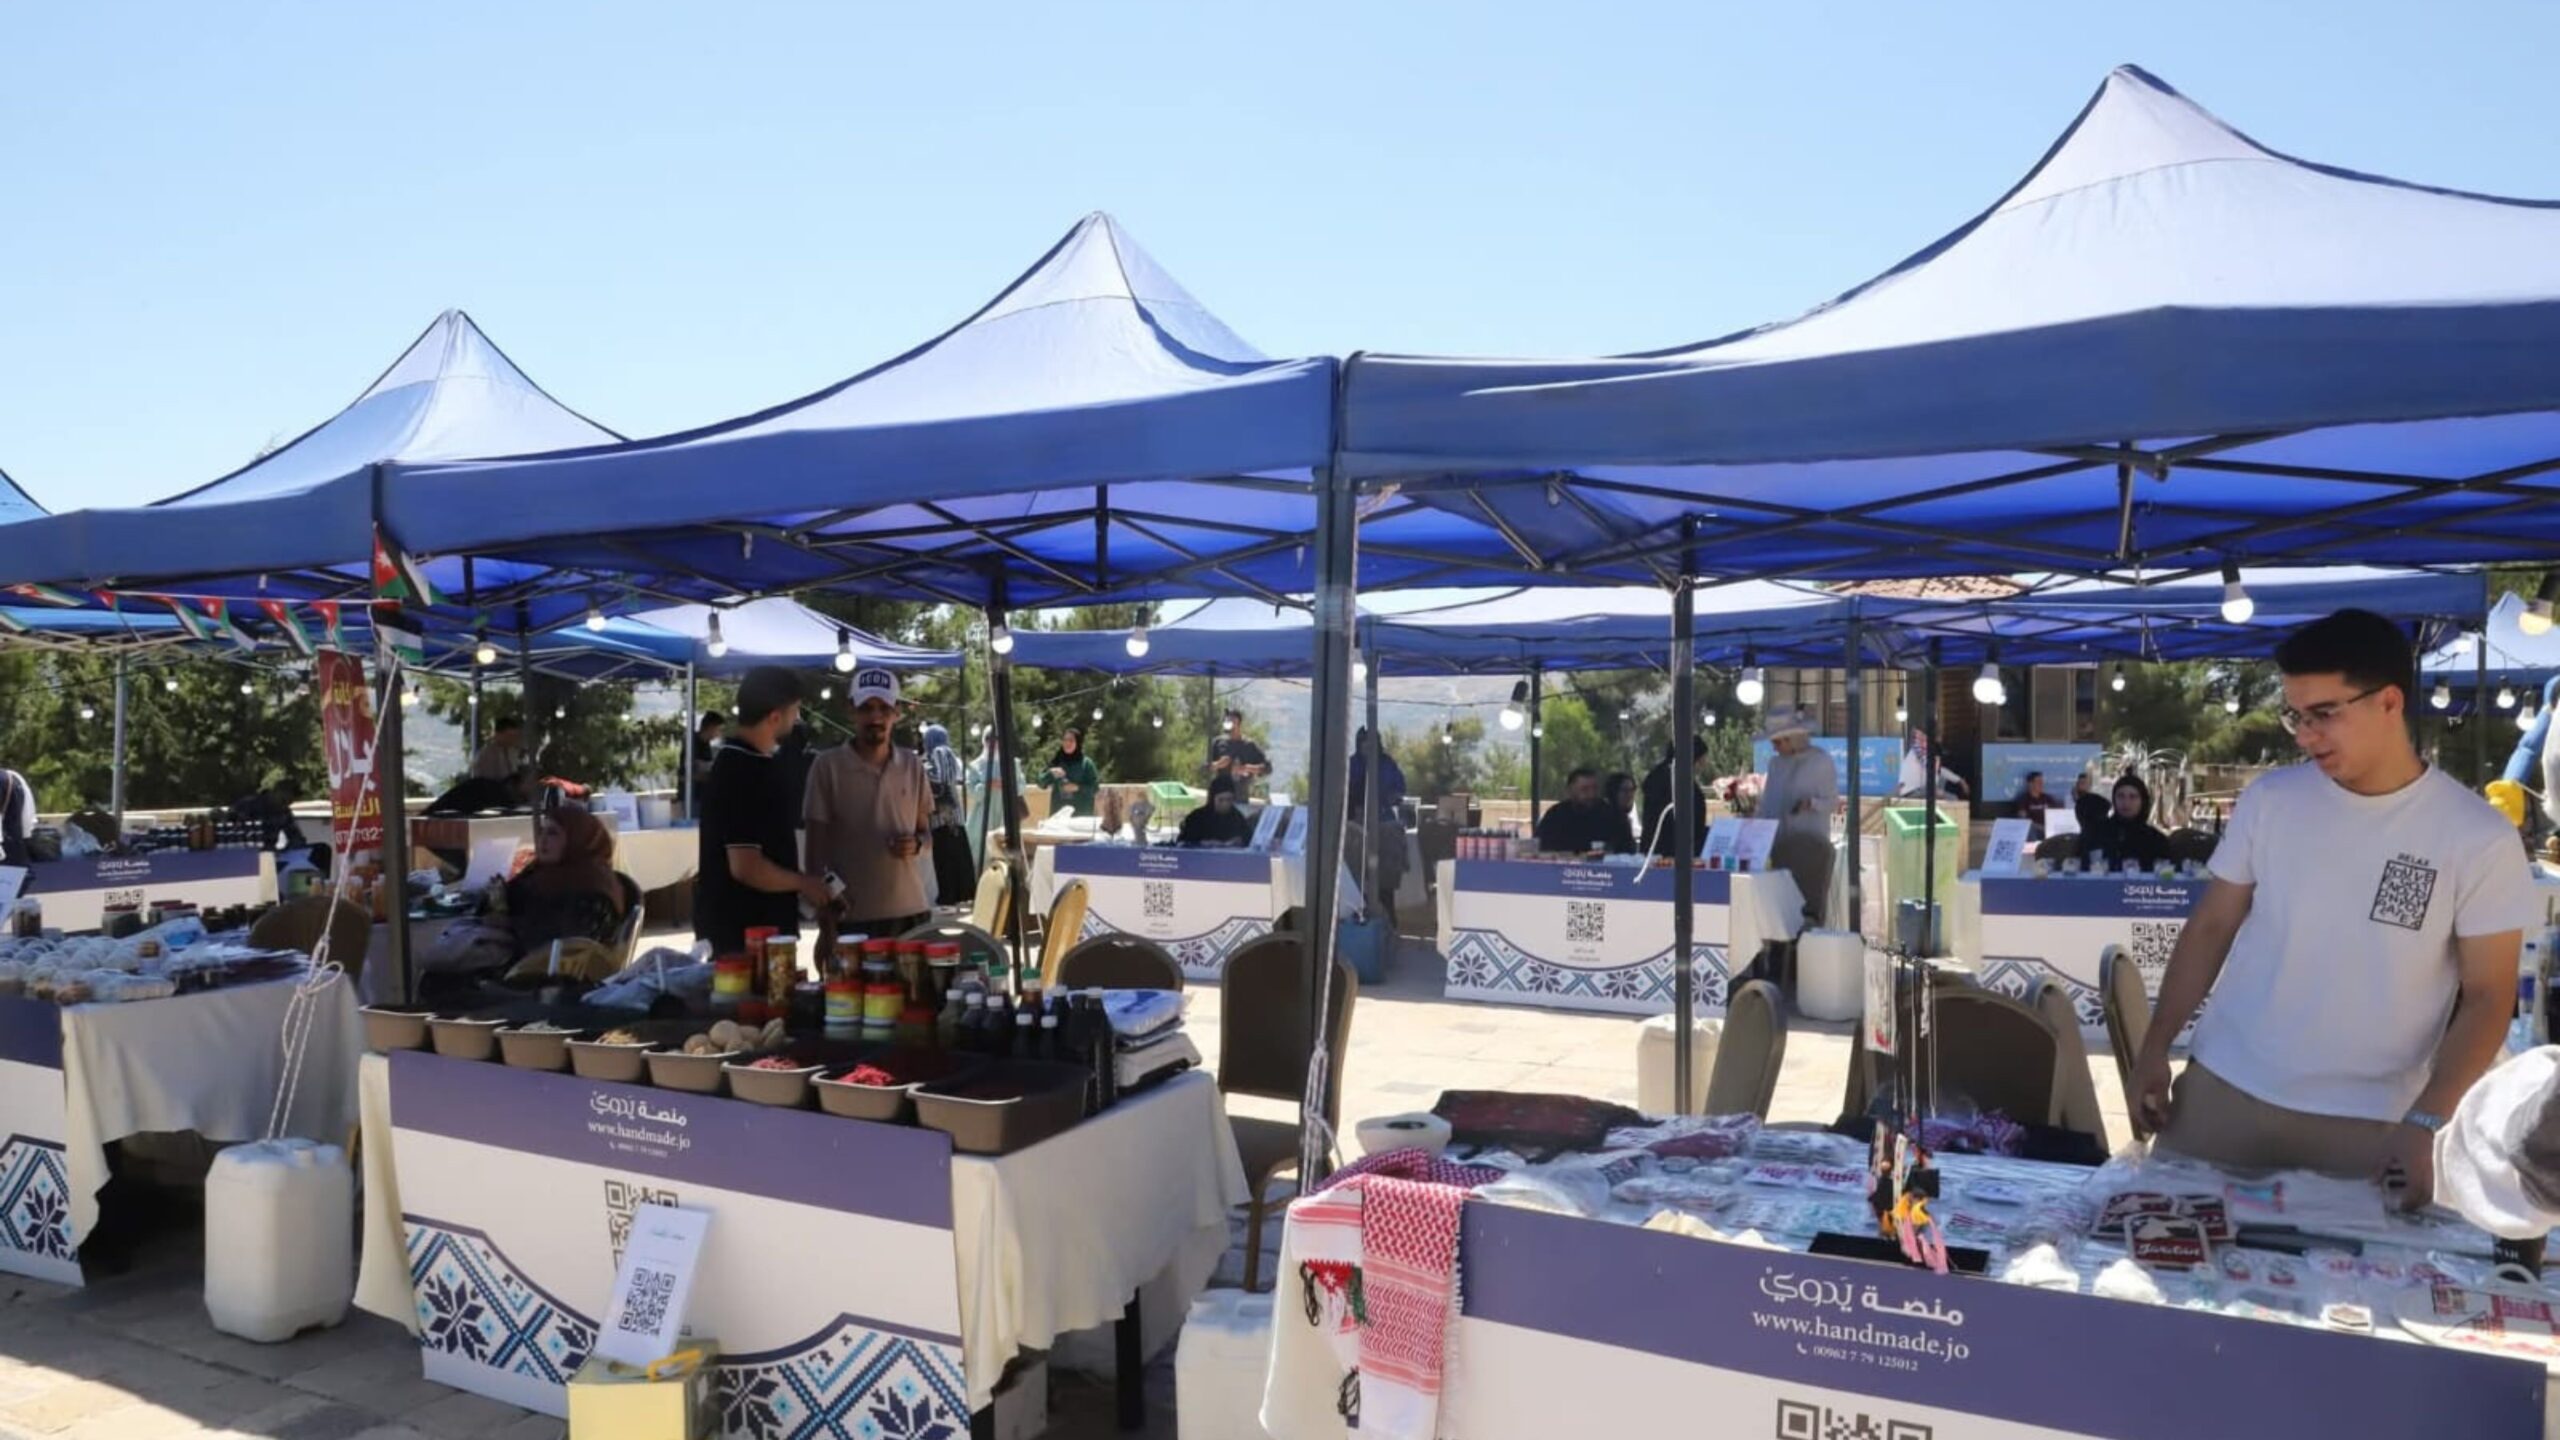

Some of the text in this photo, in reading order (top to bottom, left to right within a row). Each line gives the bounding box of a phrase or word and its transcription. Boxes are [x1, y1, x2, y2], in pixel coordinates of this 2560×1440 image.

[638, 1101, 687, 1127] منصة
[588, 1121, 691, 1152] www.handmade.jo
[1861, 1285, 1965, 1327] منصة
[1752, 1310, 1970, 1363] www.handmade.jo
[1813, 1345, 1848, 1361] 00962
[1850, 1350, 1858, 1361] 7
[1878, 1354, 1919, 1372] 125012
